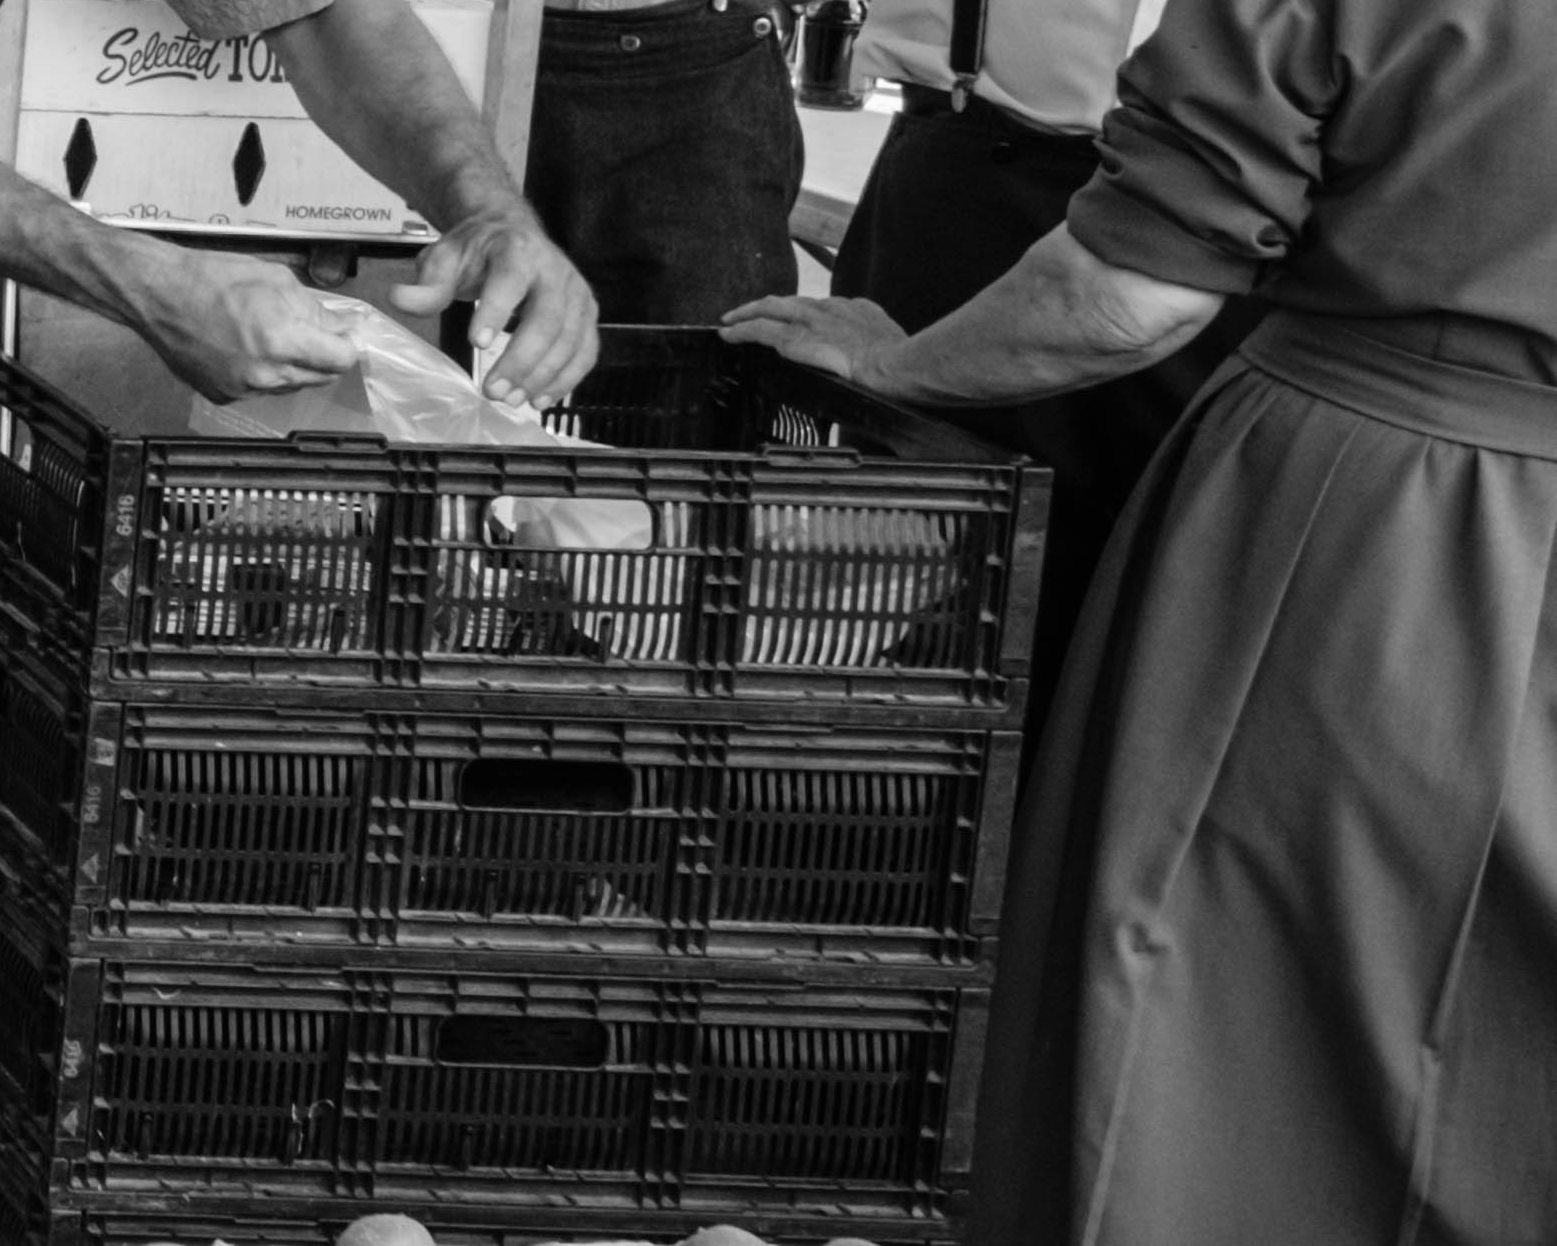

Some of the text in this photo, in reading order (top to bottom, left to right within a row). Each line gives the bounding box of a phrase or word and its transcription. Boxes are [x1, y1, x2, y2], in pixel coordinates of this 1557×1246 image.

[95, 26, 220, 86] Selected
[285, 204, 392, 221] HOMEGROWN
[116, 495, 135, 536] 6416
